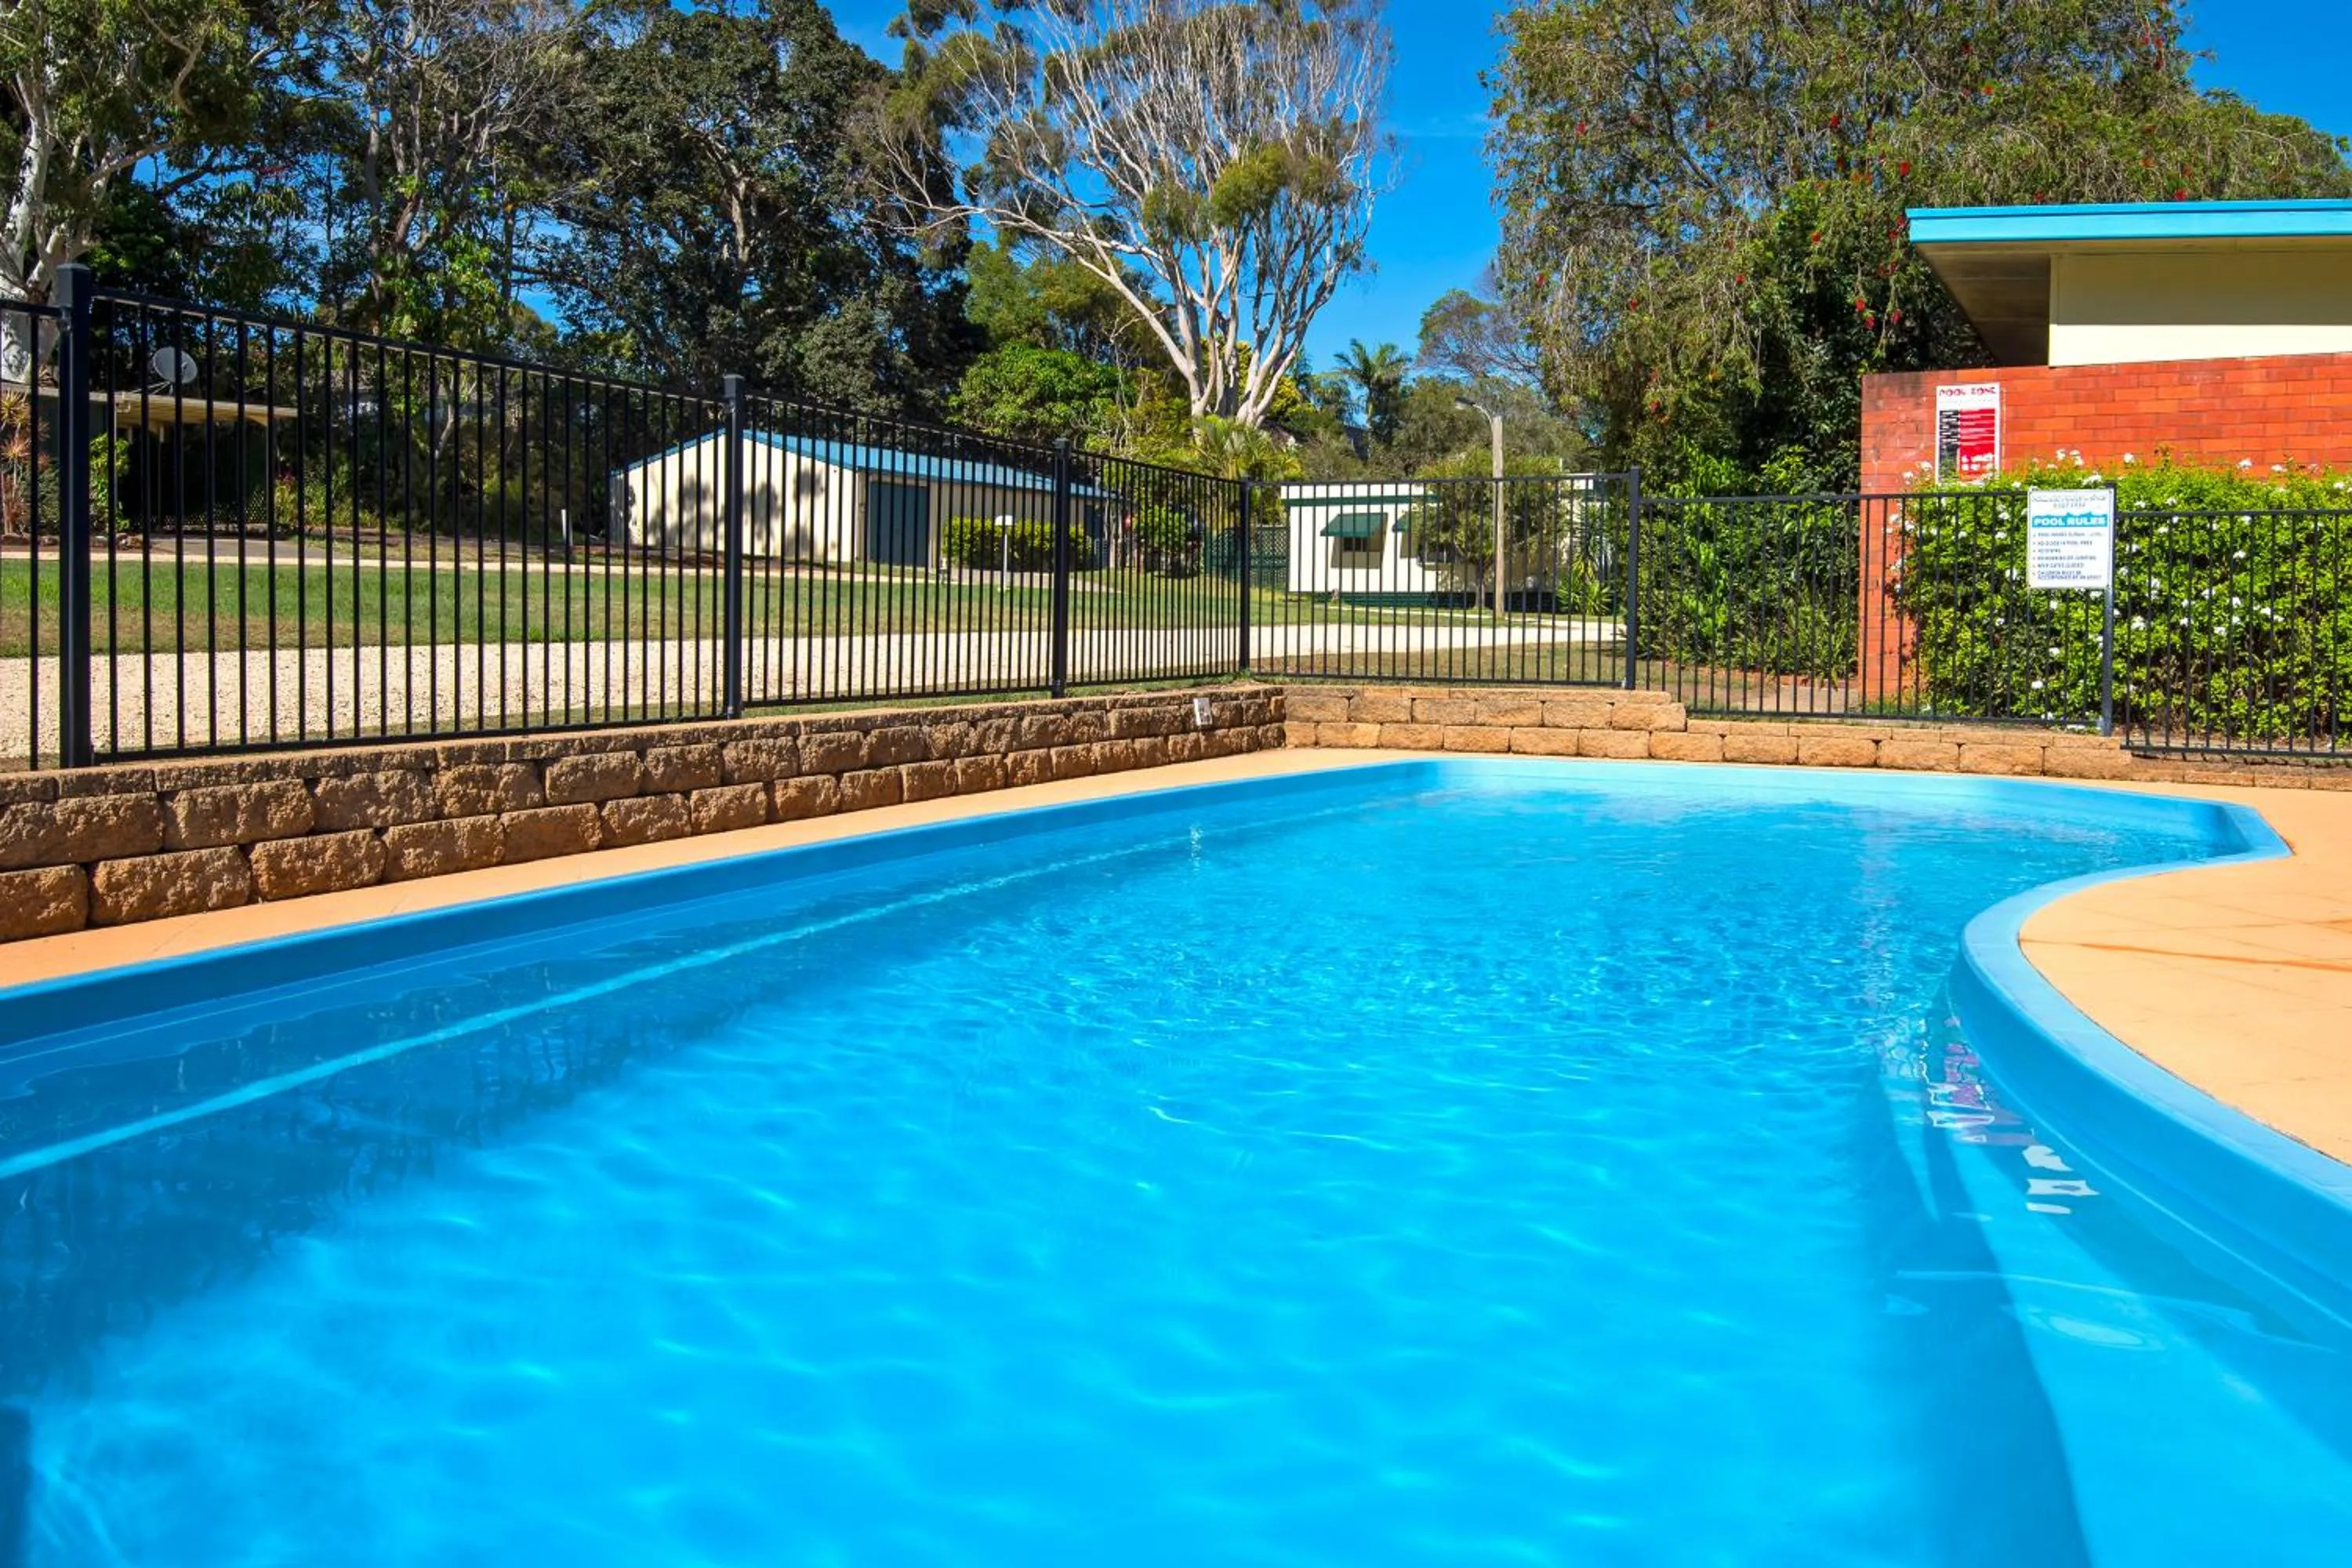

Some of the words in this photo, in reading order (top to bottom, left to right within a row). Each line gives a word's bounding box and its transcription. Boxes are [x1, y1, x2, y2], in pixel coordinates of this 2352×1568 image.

[1971, 387, 1996, 395] ZONE
[2034, 517, 2066, 526] POOL
[2067, 517, 2106, 526] RULES
